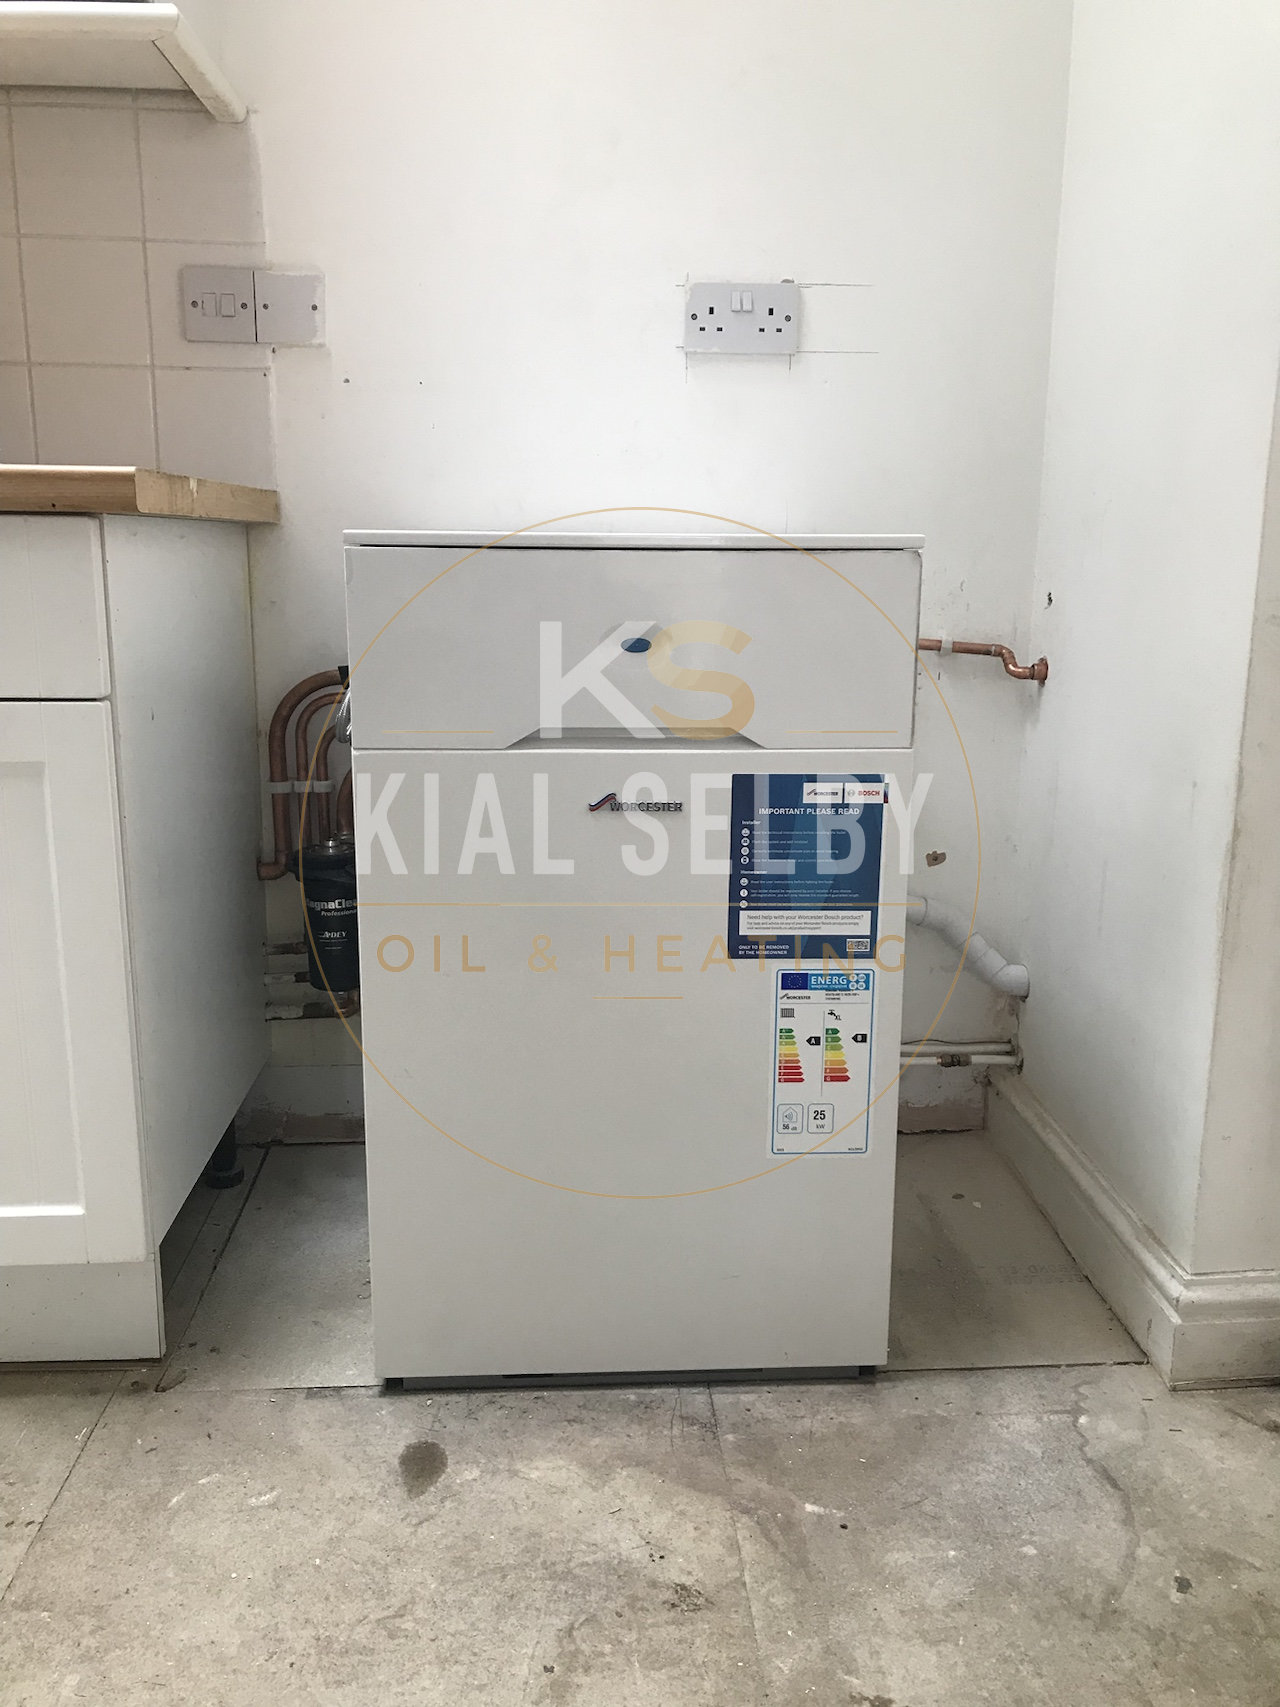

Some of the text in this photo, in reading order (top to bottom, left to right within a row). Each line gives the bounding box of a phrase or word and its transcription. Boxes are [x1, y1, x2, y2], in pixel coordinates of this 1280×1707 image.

[610, 802, 683, 812] WORCESTER
[811, 976, 847, 985] ENERG
[810, 1037, 816, 1045] A
[813, 1110, 826, 1121] 25
